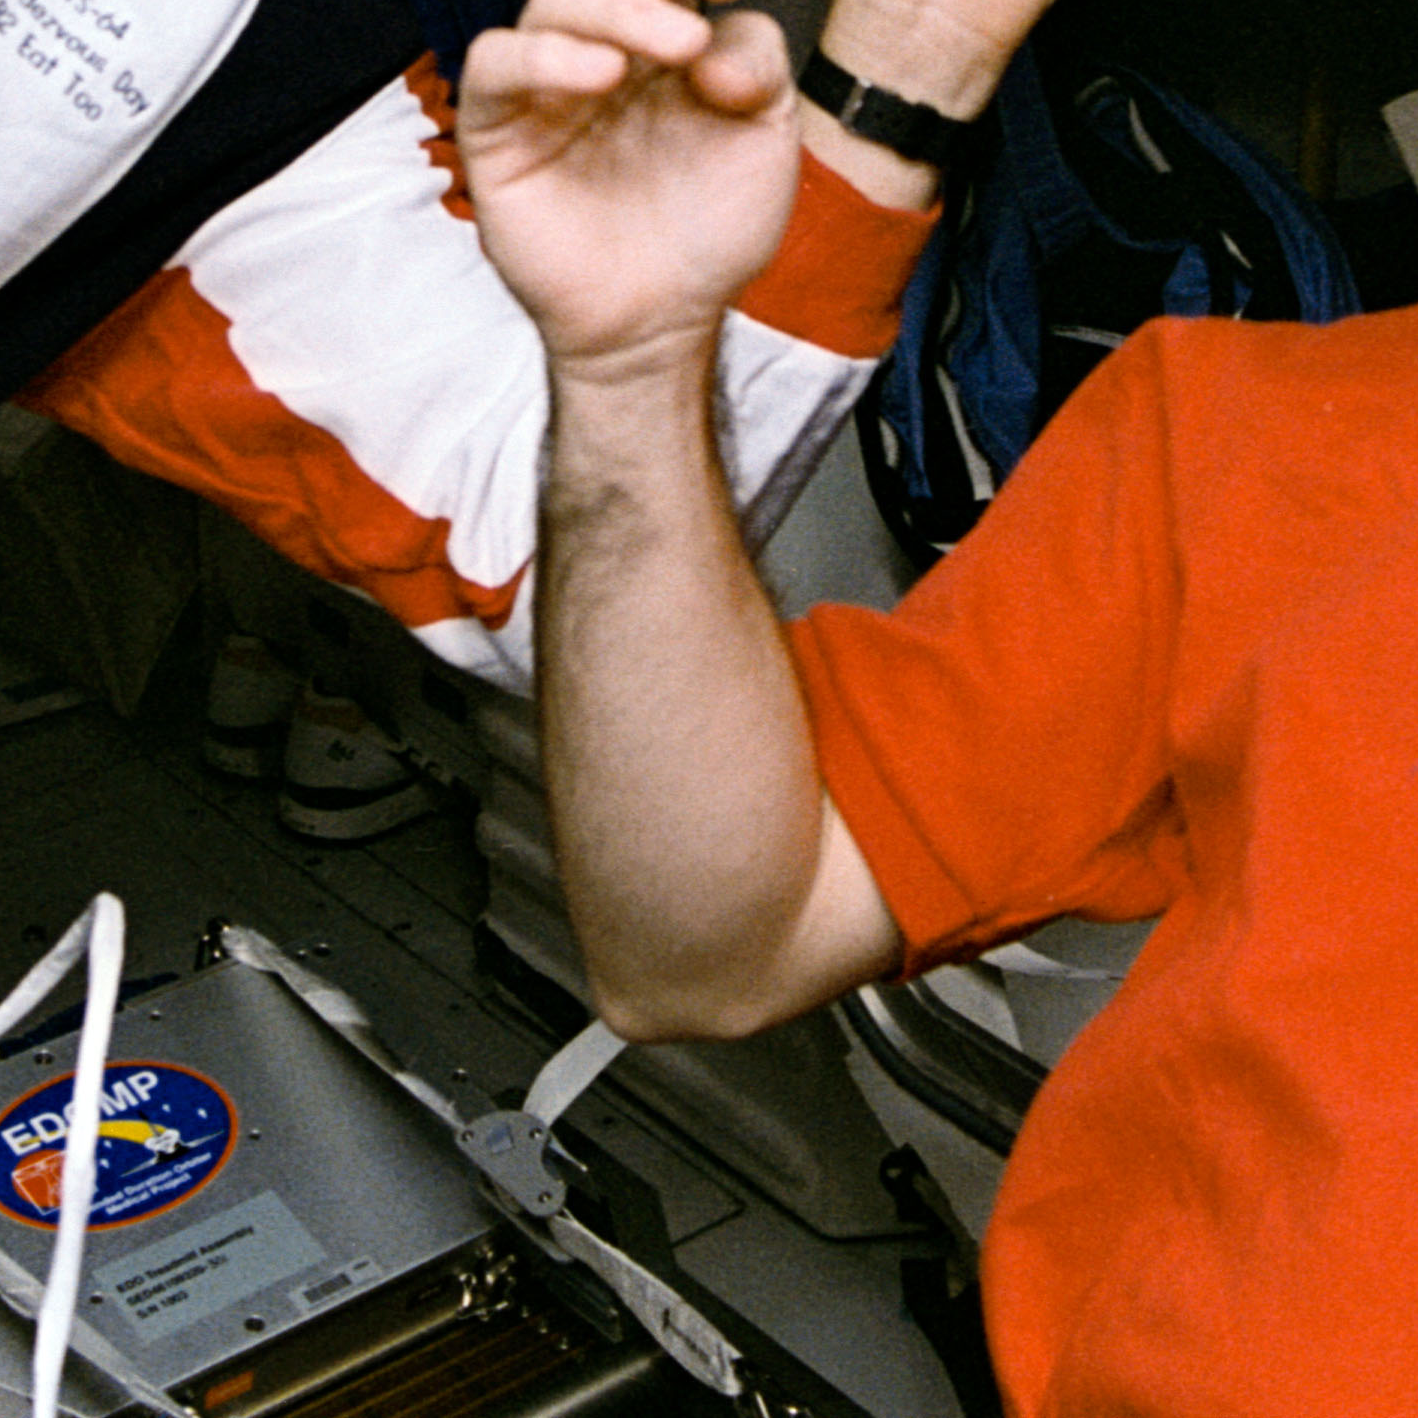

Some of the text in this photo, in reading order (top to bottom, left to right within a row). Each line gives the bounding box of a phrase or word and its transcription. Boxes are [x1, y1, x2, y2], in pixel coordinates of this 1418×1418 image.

[17, 33, 59, 76] Eat
[63, 72, 103, 121] Too
[112, 69, 150, 117] Day
